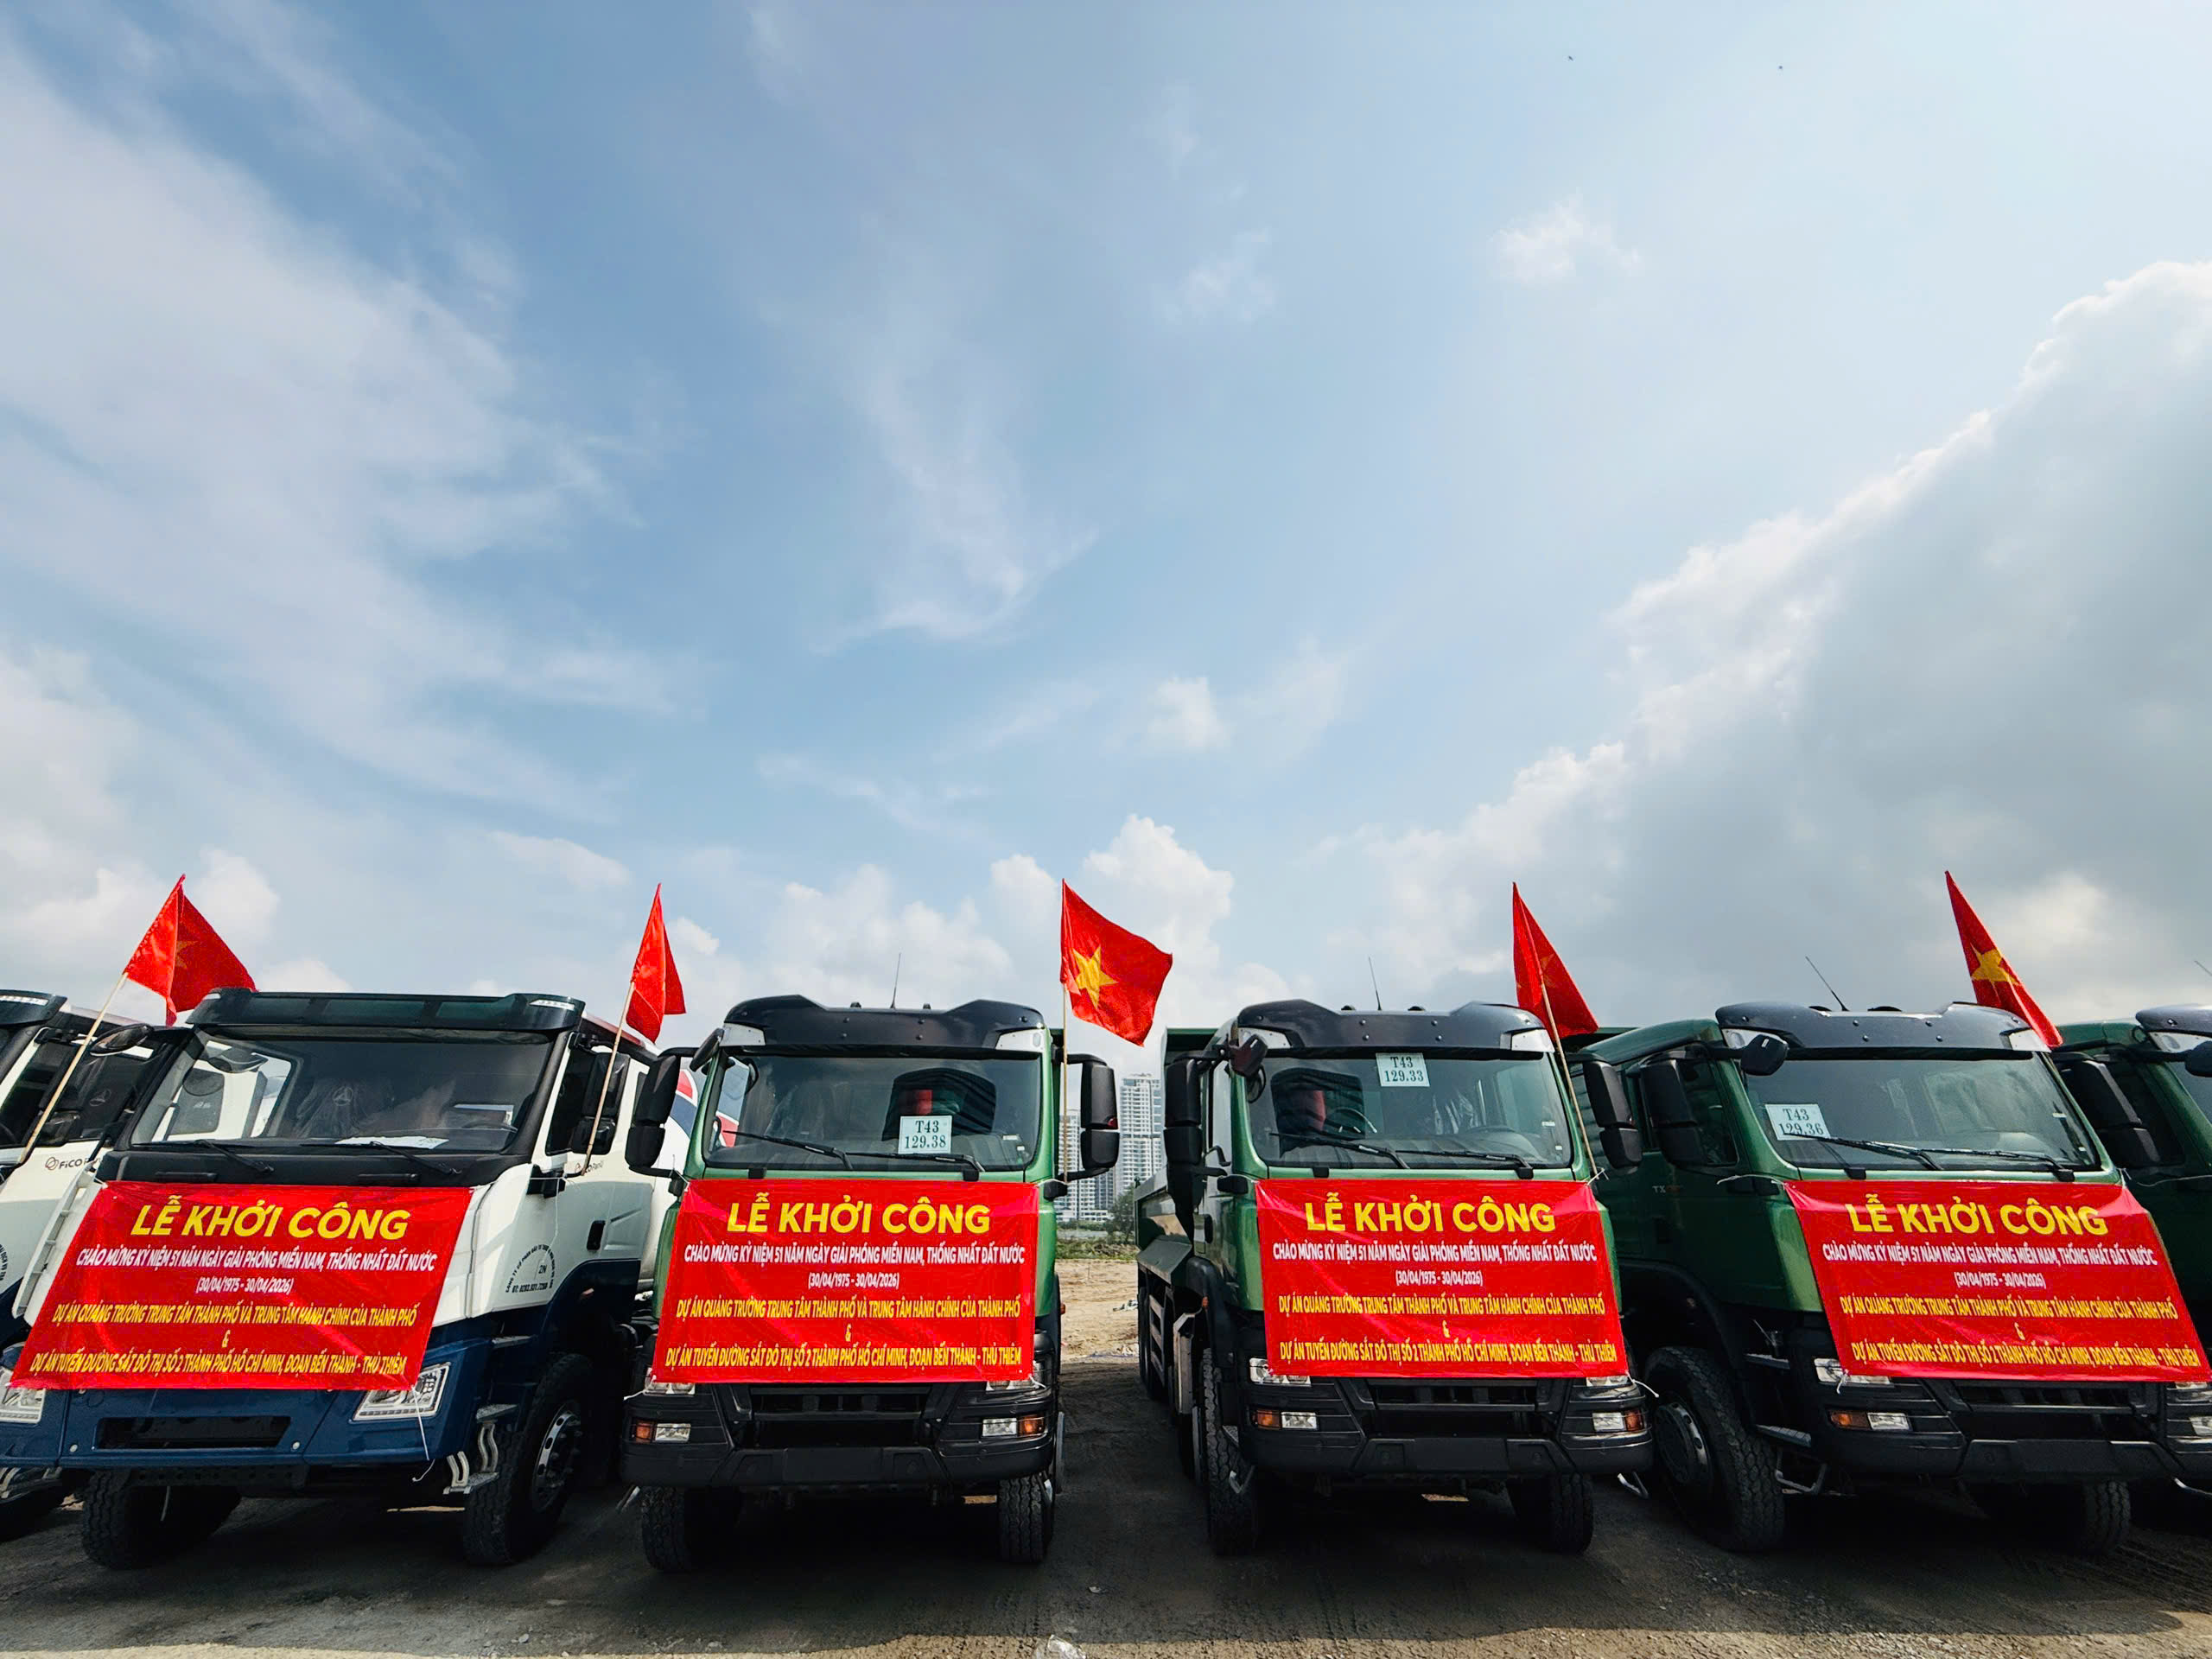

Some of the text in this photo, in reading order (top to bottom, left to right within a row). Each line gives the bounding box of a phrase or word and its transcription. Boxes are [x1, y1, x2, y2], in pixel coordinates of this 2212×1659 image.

[1390, 1056, 1414, 1068] T43
[1384, 1071, 1424, 1082] 129.33
[1783, 1108, 1809, 1121] T43
[916, 1121, 939, 1133] T43
[1779, 1122, 1824, 1135] 129.36
[906, 1135, 946, 1148] 129.38
[130, 1194, 410, 1240] LỄ KHỞI CÔNG
[727, 1192, 990, 1234] LỄ KHỞI CÔNG
[1305, 1192, 1556, 1233] LỄ KHỞI CÔNG
[1845, 1193, 2109, 1236] LỄ KHỞI CÔNG
[684, 1241, 1025, 1268] CHÀO MỪNG KỶ NIỆM 51 NĂM NGÀY GIẢI PHÓNG MIỀN NAM, THỐNG NHẤT ĐẤT NƯỚC
[1273, 1239, 1597, 1265] CHÀO MỪNG KỶ NIỆM 51 NĂM NGÀY GIẢI PHÓNG MIỀN NAM, THỐNG NHẤT ĐẤT NƯỚC
[195, 1276, 241, 1294] (30/04/1975
[245, 1276, 295, 1295] 30/04/2026)
[808, 1272, 850, 1289] (30/04/1975
[855, 1272, 899, 1289] 30/04/2026)
[1395, 1269, 1436, 1286] (30/04/1975
[1440, 1269, 1483, 1287] 30/04/2026)
[1954, 1271, 1999, 1287] (30/04/1975
[2002, 1271, 2046, 1289] 30/04/2026)
[677, 1294, 1021, 1321] DỰ ÁN QUẢNG TRƯỜNG TRUNG TÂM THÀNH PHỐ VÀ TRUNG TÂM HÀNH CHÍNH CỦA THÀNH PHỐ
[1279, 1291, 1605, 1318] DỰ ÁN QUẢNG TRƯỜNG TRUNG TÂM THÀNH PHỐ VÀ TRUNG TÂM HÀNH CHÍNH CỦA THÀNH PHỐ
